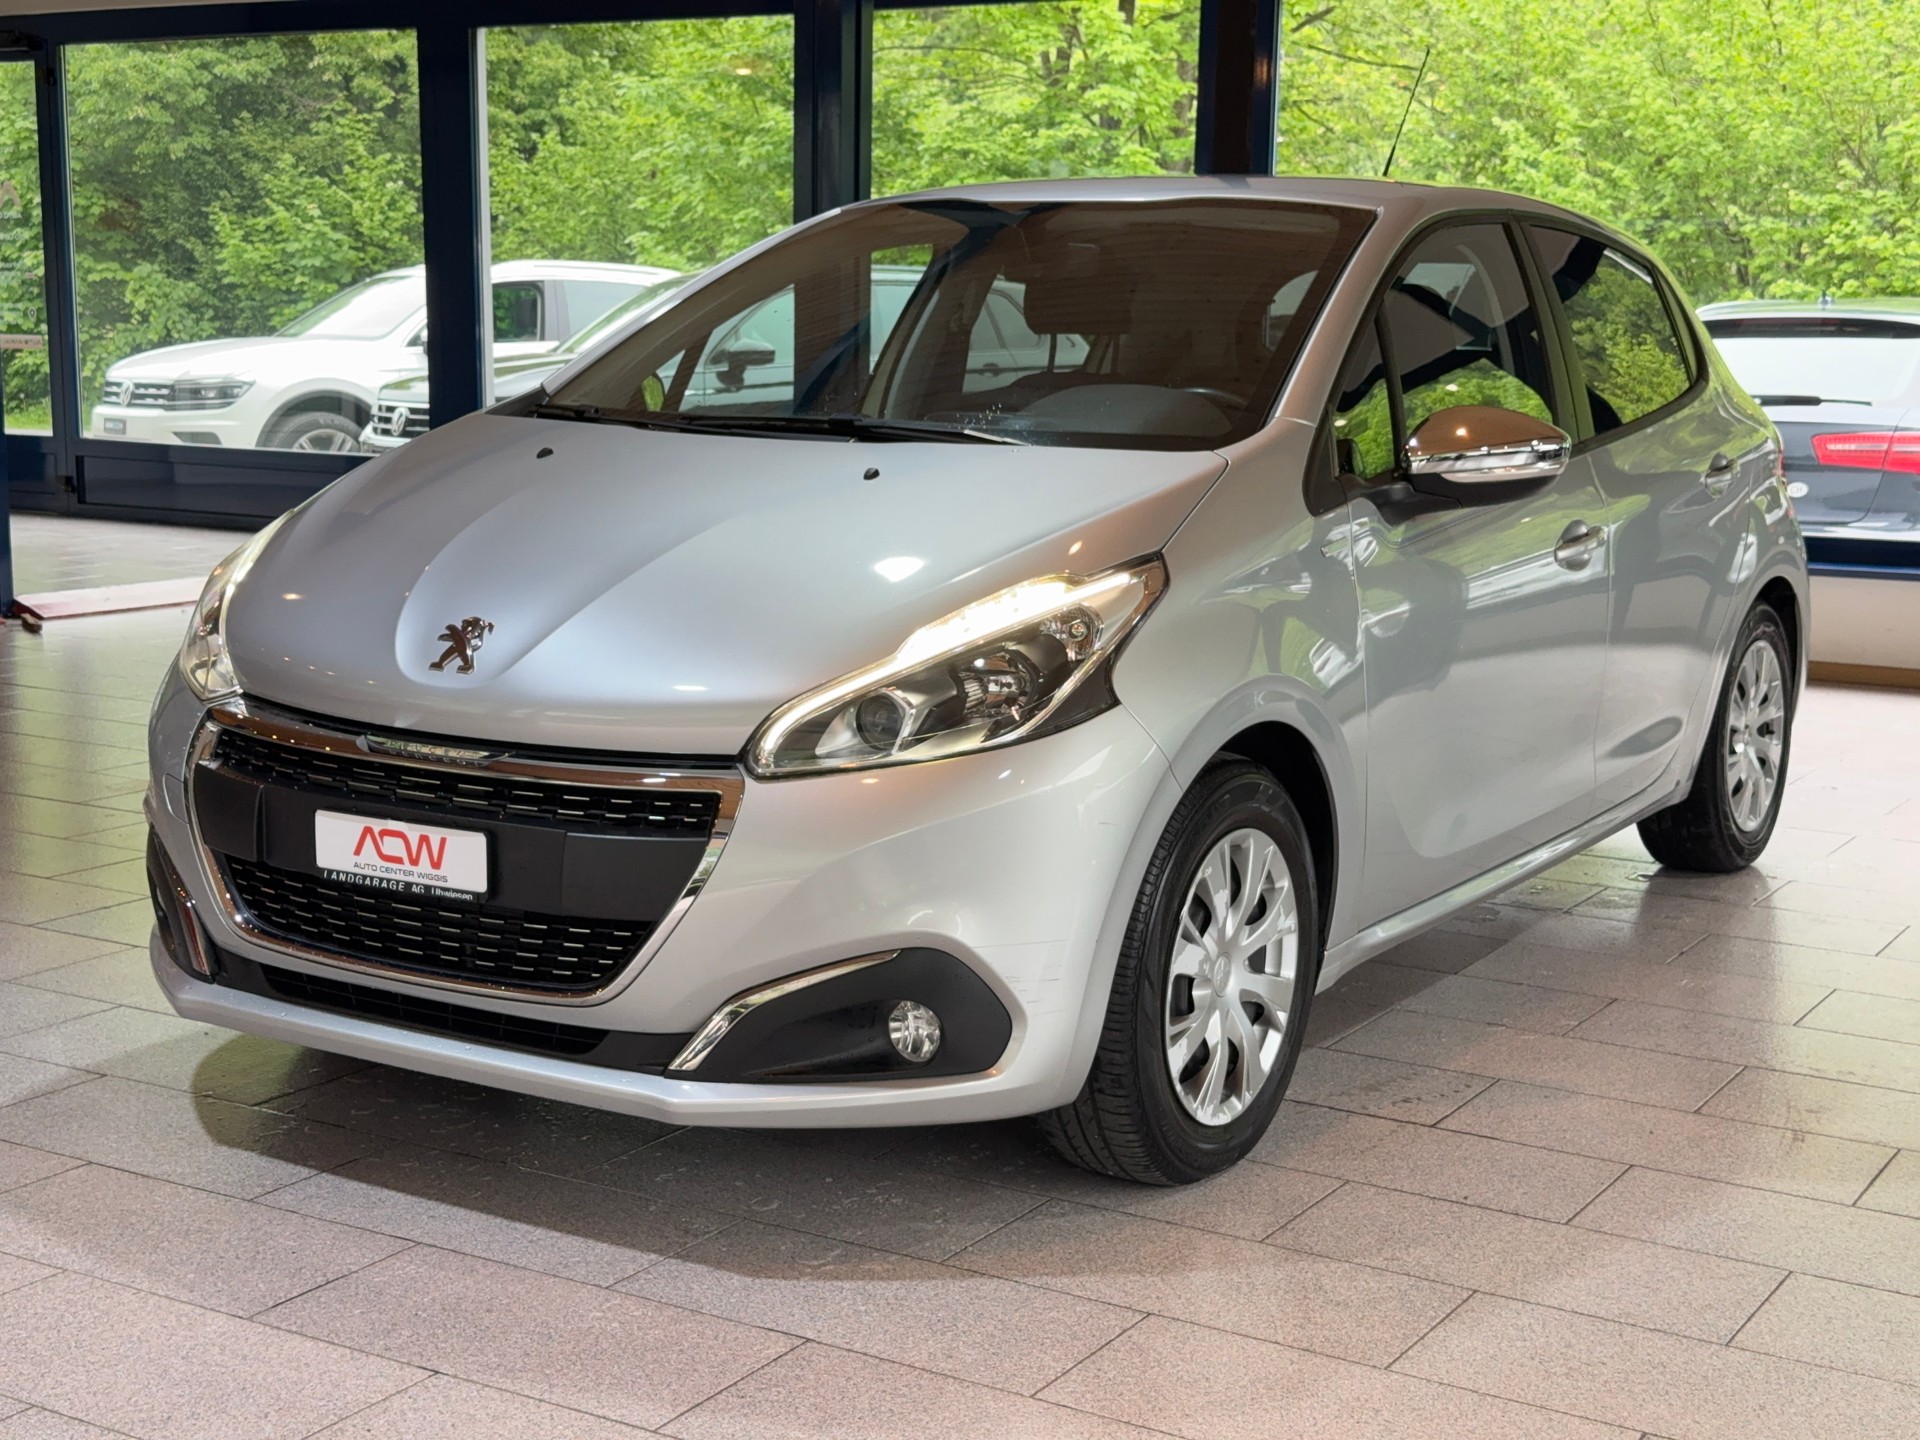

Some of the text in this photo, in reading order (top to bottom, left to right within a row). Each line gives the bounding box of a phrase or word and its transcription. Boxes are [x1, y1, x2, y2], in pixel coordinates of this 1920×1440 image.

[353, 825, 447, 870] ACW
[353, 861, 448, 883] AUTO CENTER WIGGIS
[411, 883, 424, 894] AG
